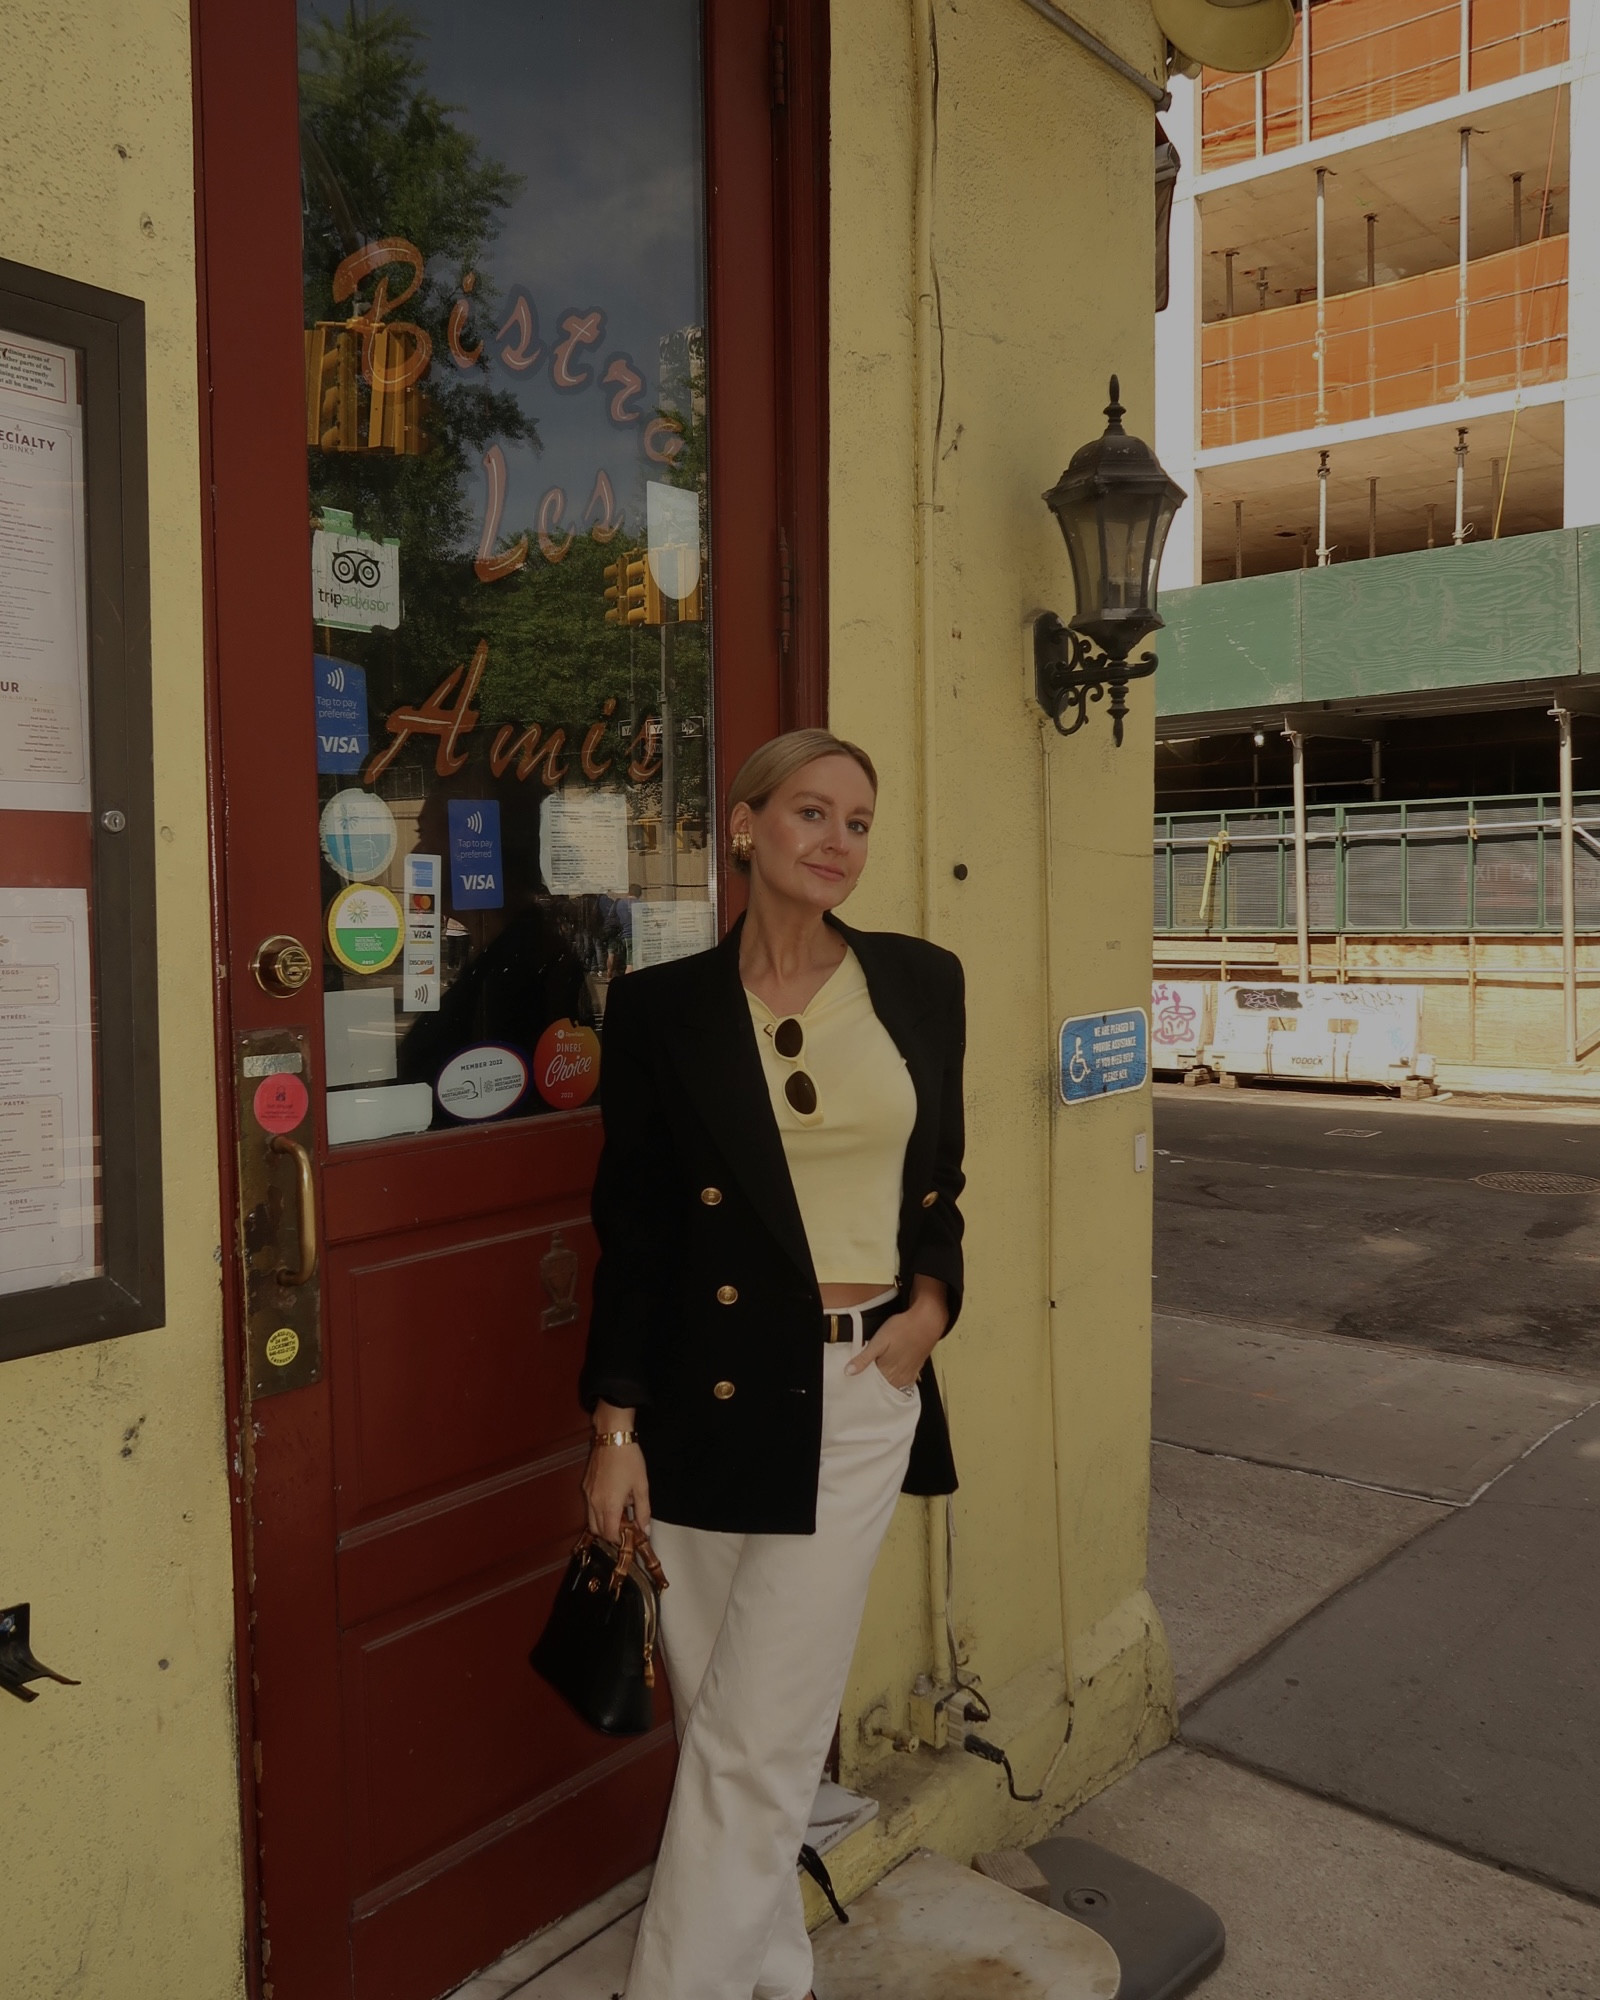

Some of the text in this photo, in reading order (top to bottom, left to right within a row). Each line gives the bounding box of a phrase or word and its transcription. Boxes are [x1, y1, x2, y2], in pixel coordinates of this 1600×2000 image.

[332, 236, 685, 464] Bistro
[3, 442, 34, 456] DRINKS
[474, 444, 626, 583] Les
[318, 588, 390, 612] tripadvisor
[316, 696, 357, 709] Tap to pay
[319, 708, 356, 718] preferred
[363, 637, 662, 786] Amis
[318, 736, 360, 753] VISA
[458, 838, 471, 847] Tap
[481, 840, 494, 848] pay
[460, 850, 492, 858] preferred
[460, 874, 495, 890] VISA
[413, 930, 432, 939] VISA
[461, 1062, 487, 1071] MEMBER
[1291, 1057, 1324, 1065] YODOCK
[545, 1054, 592, 1088] Choice
[269, 1340, 295, 1351] LOCKSMITH
